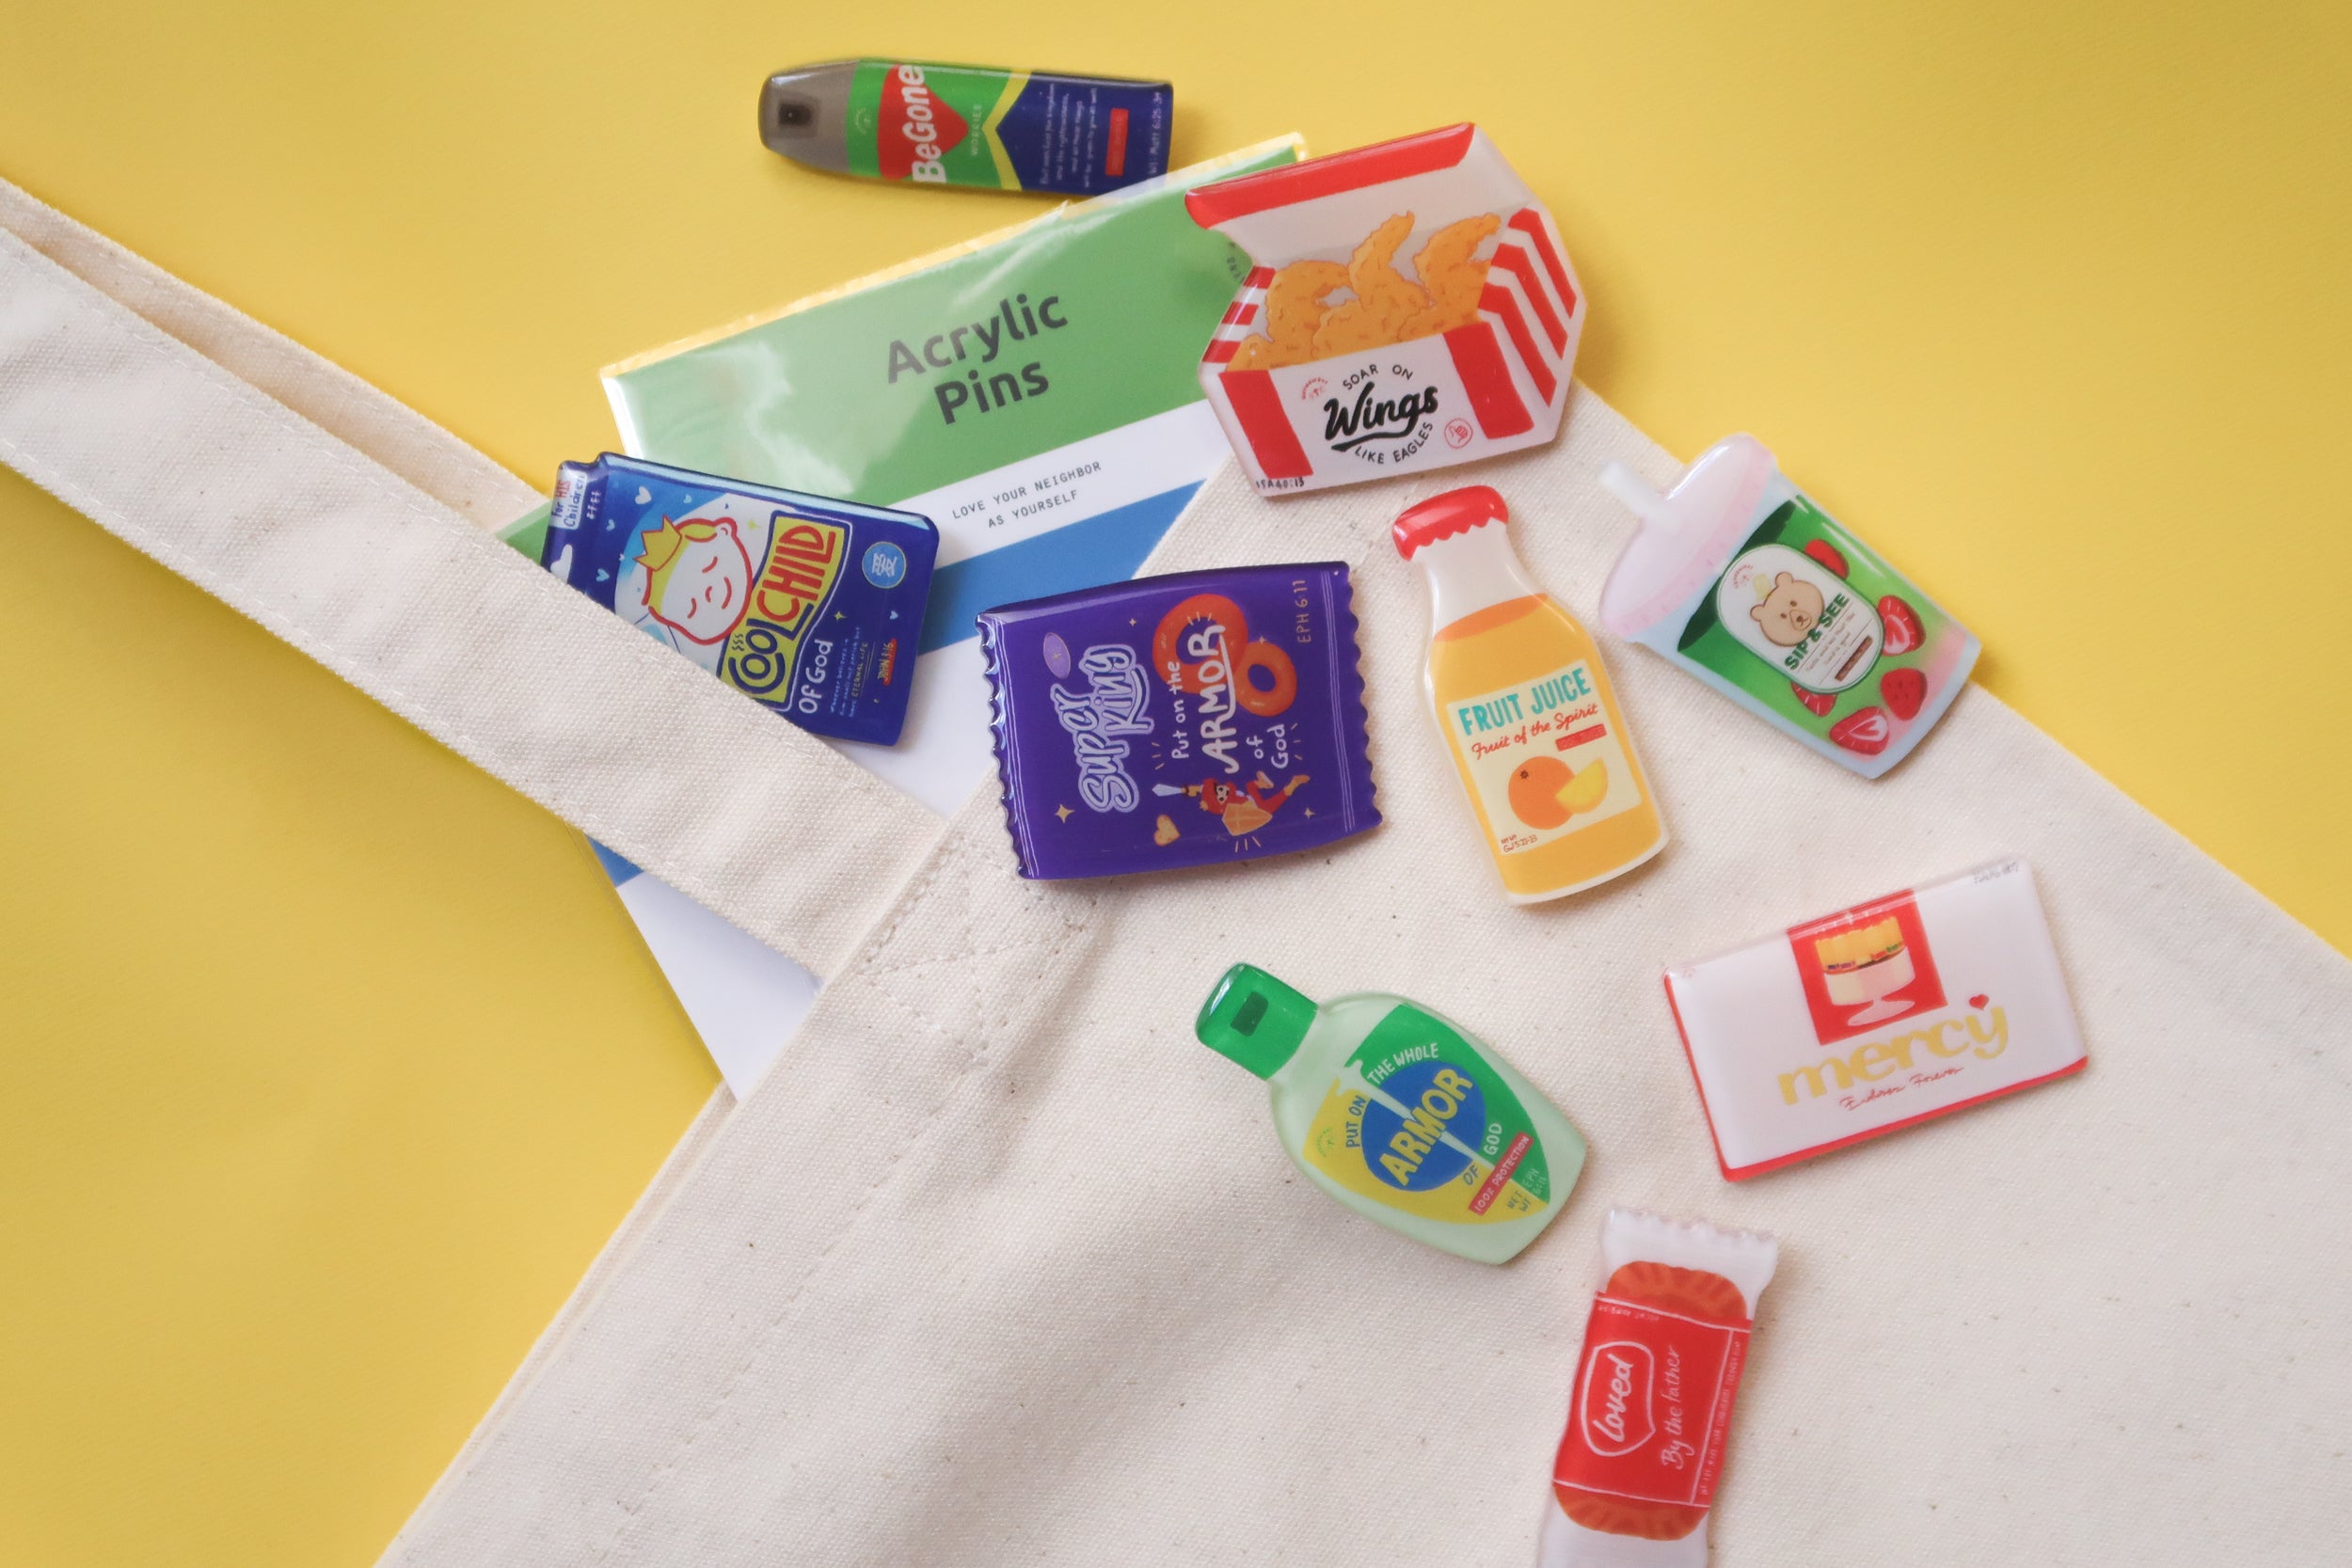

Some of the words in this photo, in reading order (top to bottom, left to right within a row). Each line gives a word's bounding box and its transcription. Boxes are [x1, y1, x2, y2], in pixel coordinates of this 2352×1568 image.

[898, 63, 947, 183] BeGone
[971, 103, 983, 156] WORRIES
[887, 293, 1068, 384] Acrylic
[934, 361, 1049, 425] Pins
[1343, 364, 1378, 390] SOAR
[1392, 364, 1413, 380] ON
[1323, 381, 1438, 451] Wings
[1355, 445, 1385, 465] LIKE
[1393, 421, 1434, 463] EAGLES
[551, 500, 564, 516] For
[554, 479, 570, 499] HIS
[562, 473, 583, 527] Children
[952, 499, 986, 520] LOVE
[993, 485, 1027, 506] YOUR
[1034, 461, 1102, 492] NEIGHBOR
[988, 514, 1005, 529] AS
[1012, 489, 1078, 518] YOURSELF
[756, 524, 835, 623] CHILD
[727, 604, 814, 694] COOL
[1296, 610, 1311, 644] EPH
[1785, 640, 1808, 671] SIP
[1807, 628, 1822, 642] &
[1819, 592, 1850, 626] SEE
[814, 639, 834, 683] God
[850, 661, 863, 697] ETERNAL
[877, 658, 890, 681] JOHN
[1167, 660, 1187, 696] the
[1079, 643, 1153, 736] King
[1187, 625, 1239, 774] ARMOR
[1458, 694, 1524, 736] FRUIT
[1531, 667, 1591, 715] JUICE
[1174, 700, 1186, 725] on
[1471, 736, 1510, 760] Fruit
[1514, 729, 1528, 746] of
[1531, 720, 1551, 737] the
[1555, 704, 1599, 731] Spirit
[1051, 684, 1139, 812] Super
[1171, 729, 1188, 759] Put
[1246, 735, 1263, 759] of
[1267, 723, 1289, 768] God
[1368, 1061, 1394, 1085] THE
[1393, 1042, 1438, 1068] WHOLE
[1778, 1006, 2008, 1106] mercy
[1350, 1095, 1366, 1118] ON
[1376, 1068, 1472, 1187] ARMOR
[1346, 1121, 1362, 1148] PUT
[1463, 1165, 1480, 1186] OF
[1484, 1122, 1502, 1155] GOD
[1492, 1135, 1530, 1187] PROTECTION
[1523, 1167, 1539, 1188] EPH
[1663, 1405, 1682, 1434] the
[1661, 1437, 1694, 1470] By
